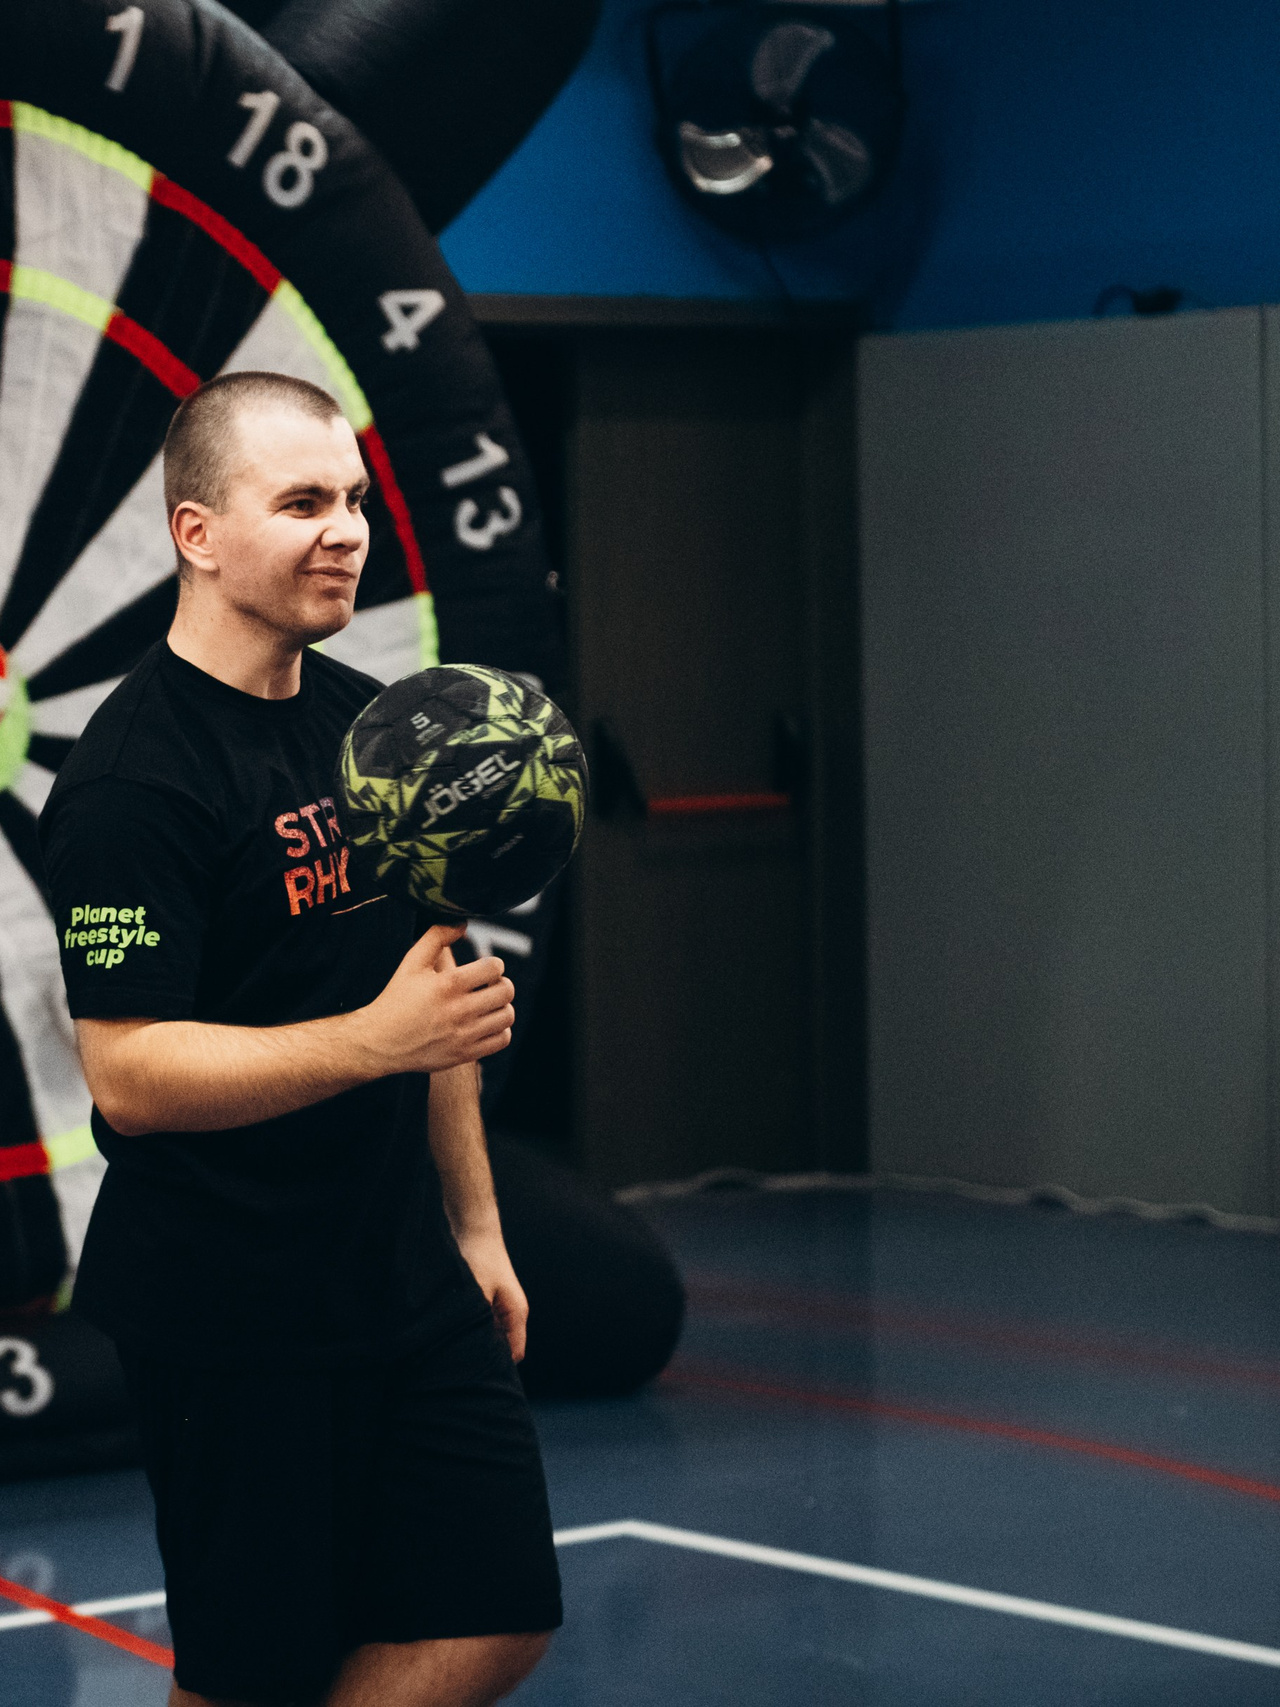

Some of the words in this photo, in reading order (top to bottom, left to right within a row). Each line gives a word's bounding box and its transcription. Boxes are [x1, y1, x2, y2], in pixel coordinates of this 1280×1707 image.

[104, 5, 145, 92] 1
[226, 89, 328, 209] 18
[377, 288, 446, 353] 4
[440, 431, 522, 551] 13
[422, 752, 522, 830] JÖGEL
[64, 925, 161, 949] freestyle
[71, 904, 147, 946] Planet
[86, 949, 125, 969] cup
